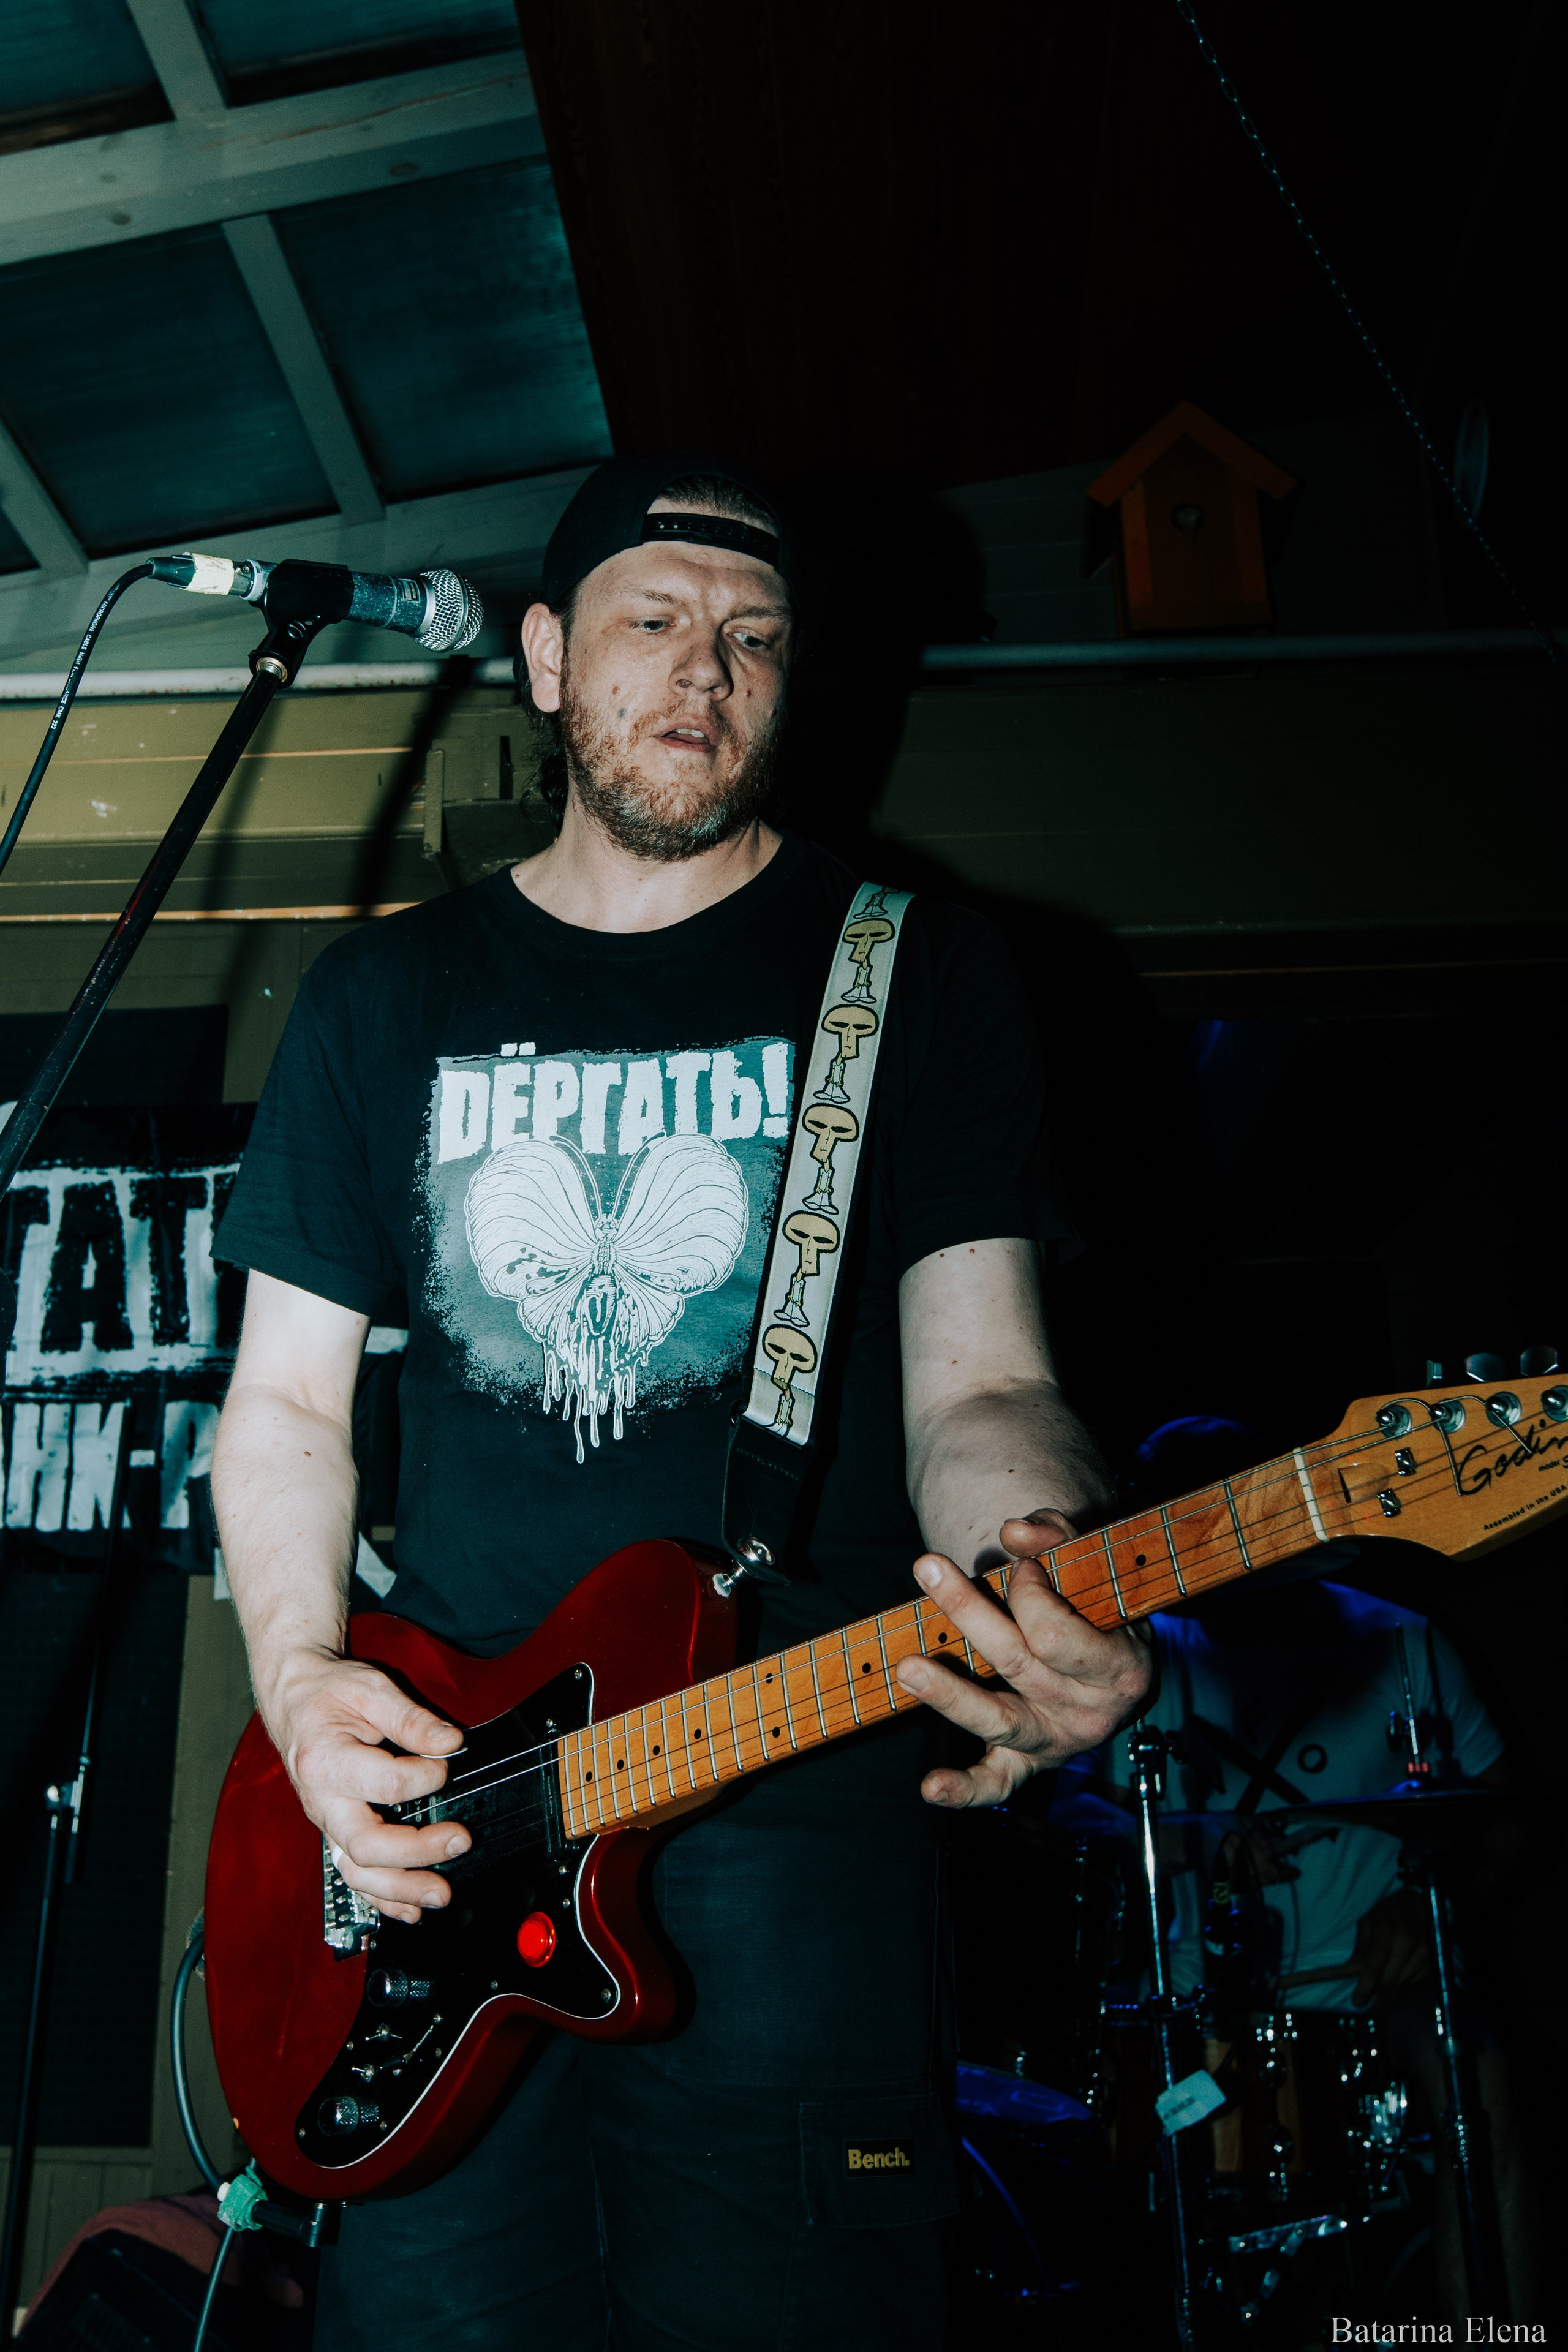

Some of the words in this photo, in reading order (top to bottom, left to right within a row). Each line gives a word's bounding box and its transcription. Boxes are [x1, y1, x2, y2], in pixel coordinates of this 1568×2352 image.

[89, 601, 108, 632] MICROPHONE
[81, 634, 92, 650] CABLE
[50, 720, 59, 730] 222
[1483, 1507, 1526, 1531] Assembled
[1536, 1495, 1549, 1505] the
[1549, 1484, 1567, 1496] USA
[848, 2146, 911, 2169] Bench.
